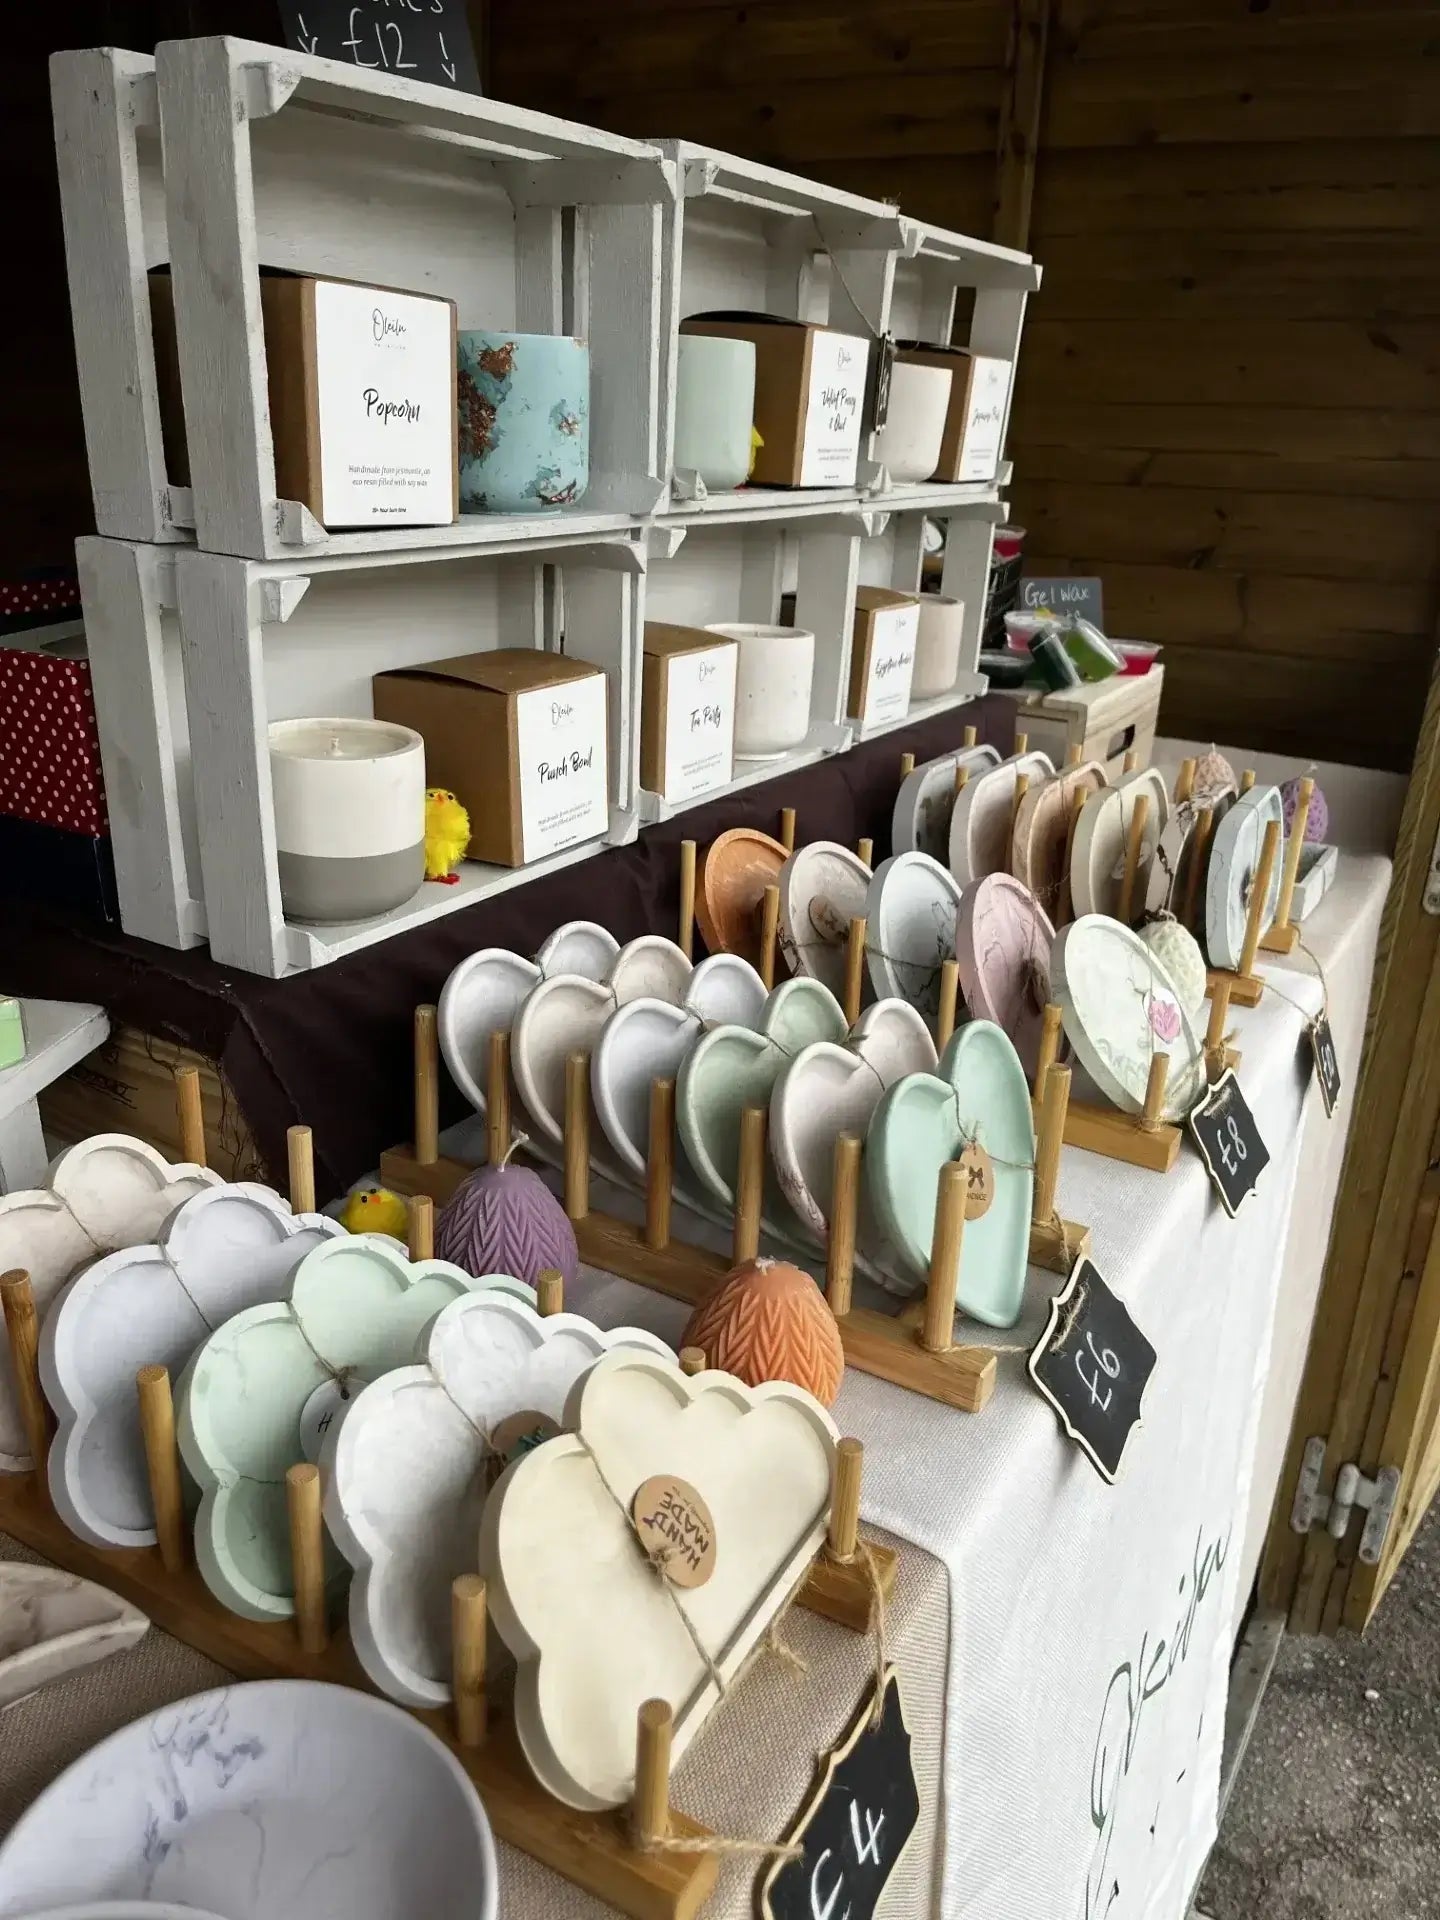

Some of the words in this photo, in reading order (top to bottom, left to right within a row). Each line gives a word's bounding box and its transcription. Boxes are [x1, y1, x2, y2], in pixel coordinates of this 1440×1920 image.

[342, 7, 417, 67] £12
[363, 388, 420, 425] Popcorn
[1024, 582, 1056, 607] Gel
[1060, 583, 1089, 602] wax
[703, 705, 721, 728] Party
[537, 757, 568, 784] Punch
[570, 746, 593, 772] Bowl
[1216, 1115, 1247, 1176] £8
[1075, 1331, 1121, 1412] £6
[659, 1490, 710, 1553] MADE
